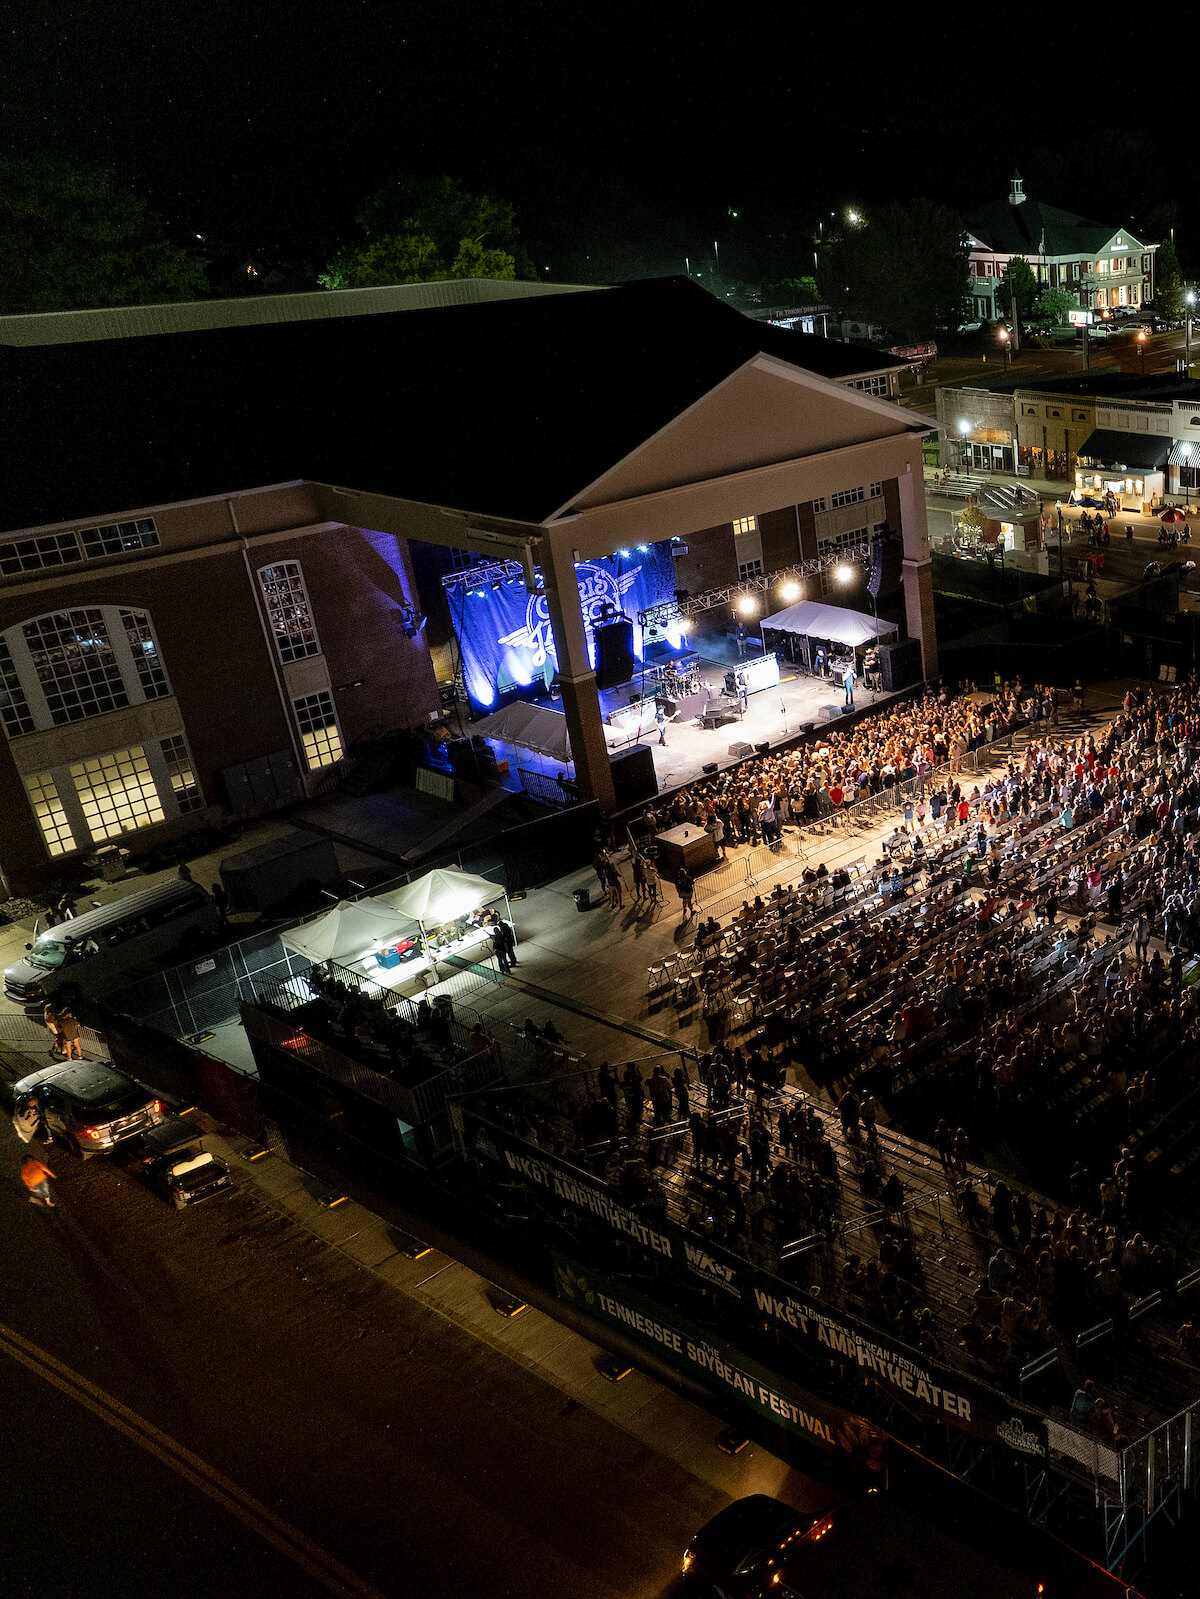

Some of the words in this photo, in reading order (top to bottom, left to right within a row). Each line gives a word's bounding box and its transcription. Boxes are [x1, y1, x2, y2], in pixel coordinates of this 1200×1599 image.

[553, 1180, 673, 1260] AMPHITHEATER
[597, 1292, 684, 1355] TENNESSEE
[686, 1341, 756, 1400] SOYBEAN
[758, 1387, 836, 1446] FESTIVAL
[700, 1340, 721, 1360] THE
[817, 1321, 972, 1422] AMPHITHEATER
